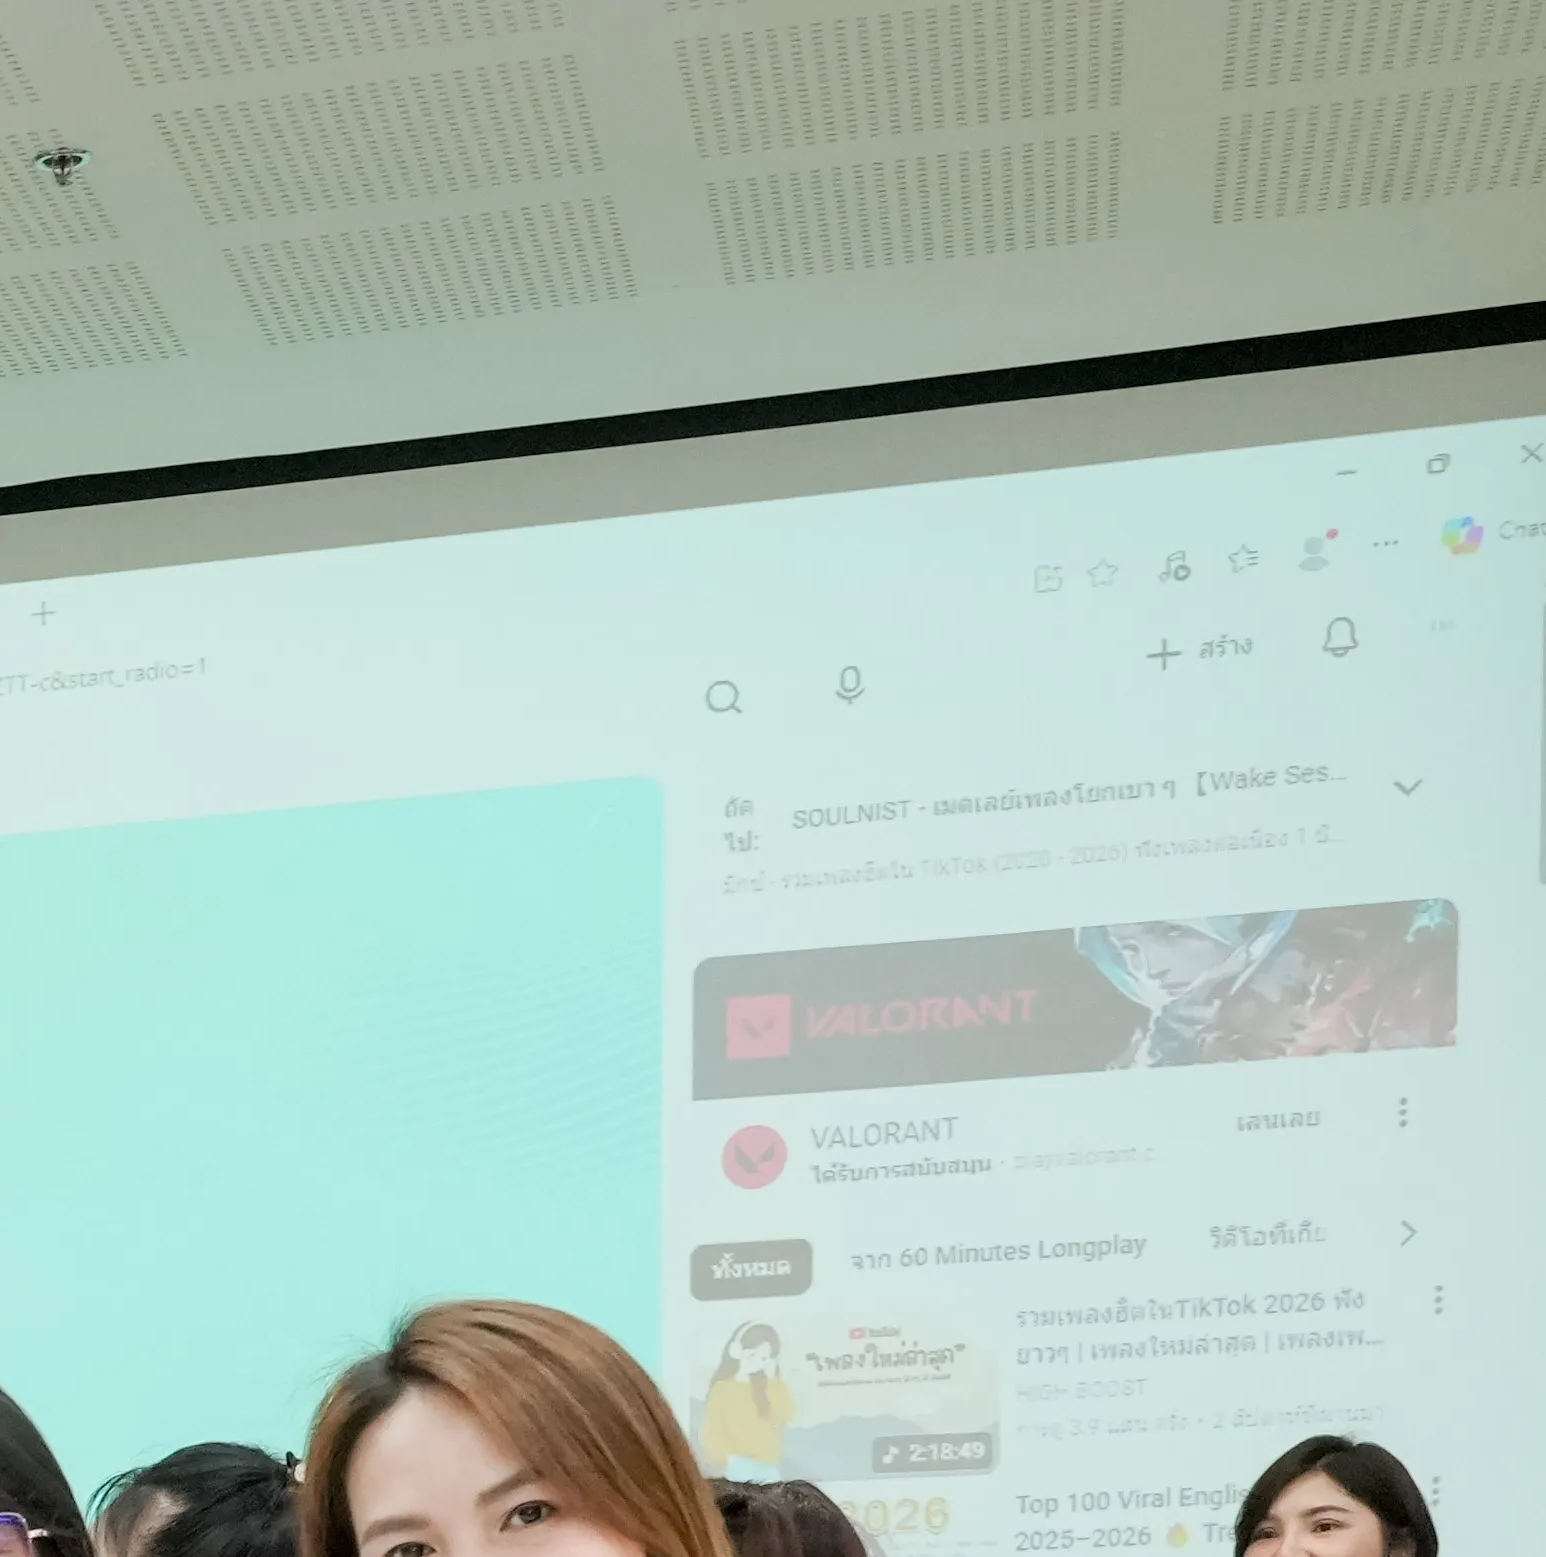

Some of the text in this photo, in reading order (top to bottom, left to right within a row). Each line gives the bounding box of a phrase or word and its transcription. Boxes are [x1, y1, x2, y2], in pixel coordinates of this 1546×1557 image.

[1198, 634, 1254, 660] สร้าง
[791, 799, 912, 830] SOULNIST
[921, 855, 988, 879] TikTok
[806, 989, 1040, 1040] VALORANT
[810, 1116, 960, 1151] VALORANT
[710, 1251, 793, 1281] ทั้งหมด
[899, 1246, 928, 1269] 60
[935, 1242, 1031, 1267] Minutes
[1038, 1234, 1148, 1263] Longplay
[1263, 1291, 1326, 1316] 2026
[908, 1441, 987, 1464] 2:18:49
[1016, 1482, 1249, 1519] Top 100 Viral Englis
[1202, 1523, 1237, 1545] Tre
